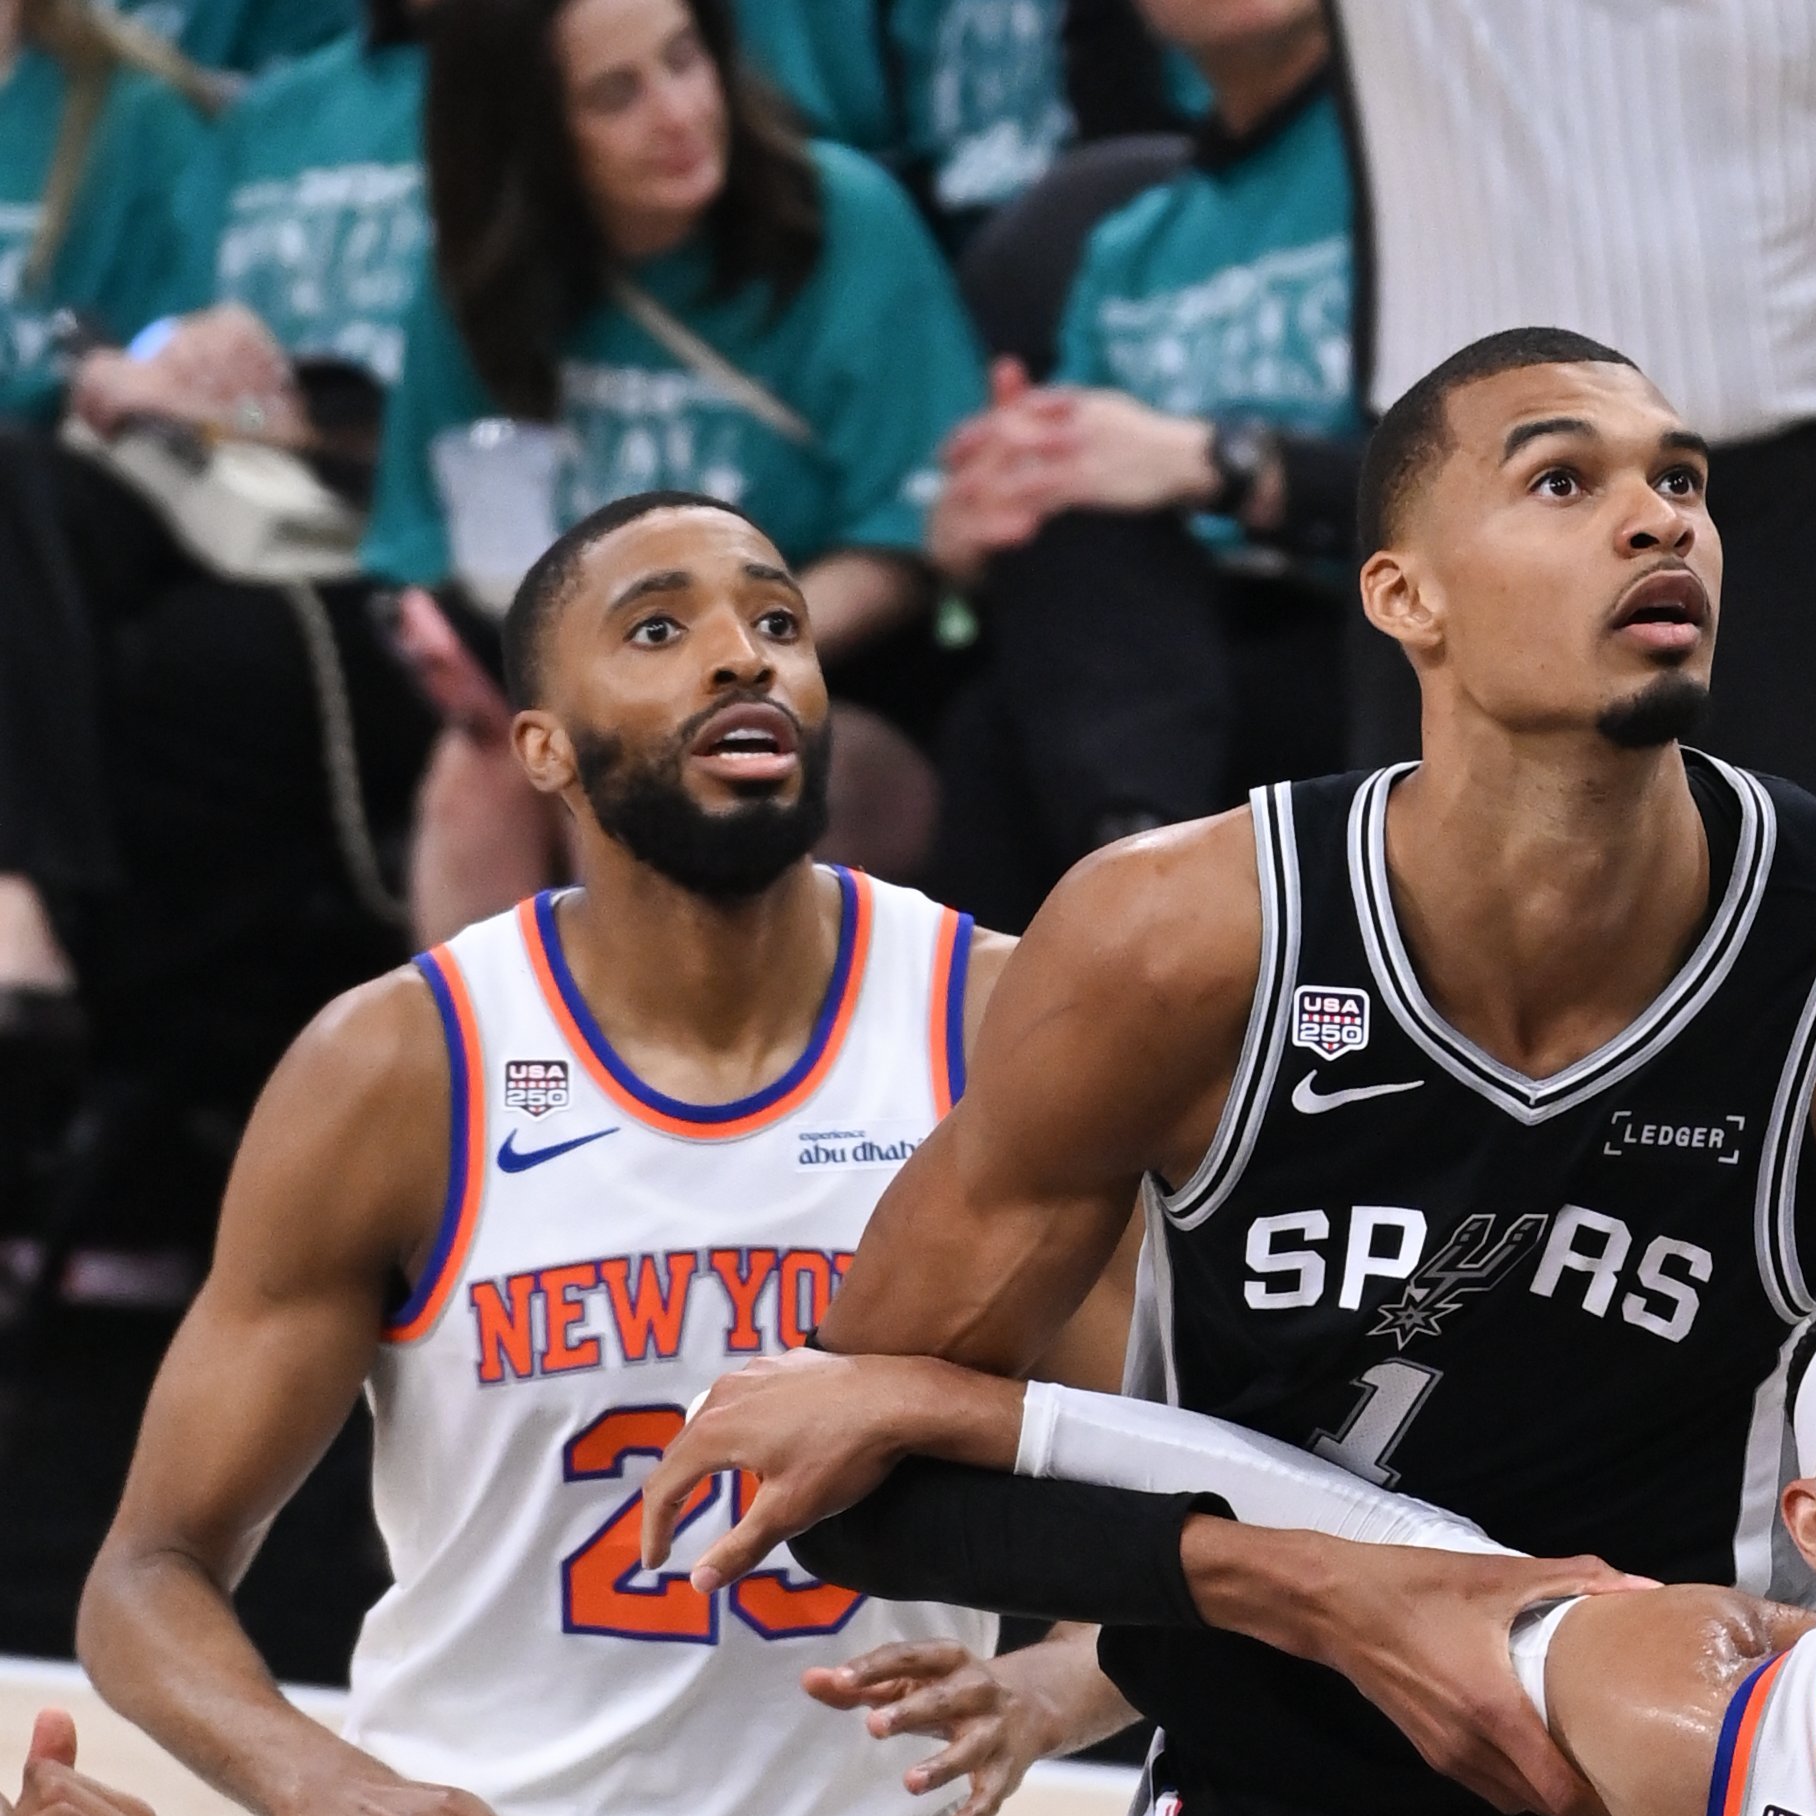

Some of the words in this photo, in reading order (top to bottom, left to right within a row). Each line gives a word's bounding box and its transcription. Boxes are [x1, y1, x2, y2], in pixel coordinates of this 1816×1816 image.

[1303, 995, 1360, 1015] USA
[1299, 1023, 1363, 1044] 250
[509, 1064, 565, 1079] USA
[506, 1089, 568, 1106] 250
[1622, 1122, 1726, 1149] LEDGER
[798, 1143, 847, 1165] abu
[852, 1138, 924, 1162] dhab
[468, 1250, 699, 1386] NEW
[708, 1247, 858, 1353] YO
[1306, 1356, 1445, 1490] 1
